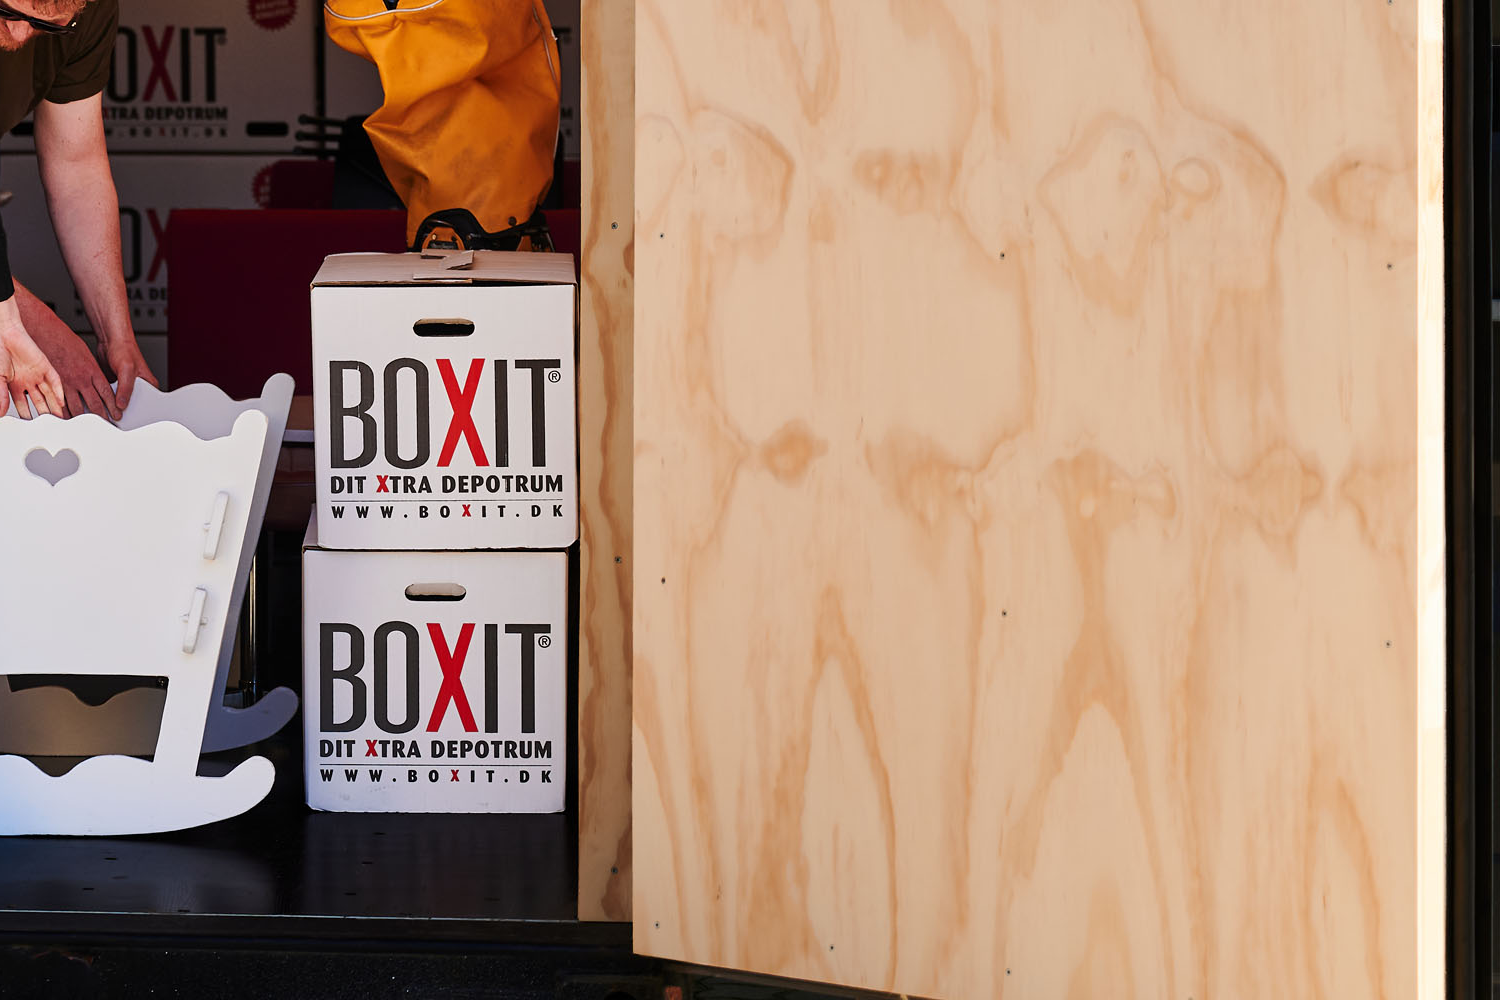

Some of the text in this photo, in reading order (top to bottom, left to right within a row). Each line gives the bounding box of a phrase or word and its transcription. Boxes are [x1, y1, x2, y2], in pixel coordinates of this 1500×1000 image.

[108, 25, 227, 102] OXIT®
[145, 106, 227, 120] DEPOTRUM
[331, 475, 562, 494] DIT XTRA DEPOTRUM
[320, 740, 551, 758] DIT XTRA DEPOTRUM
